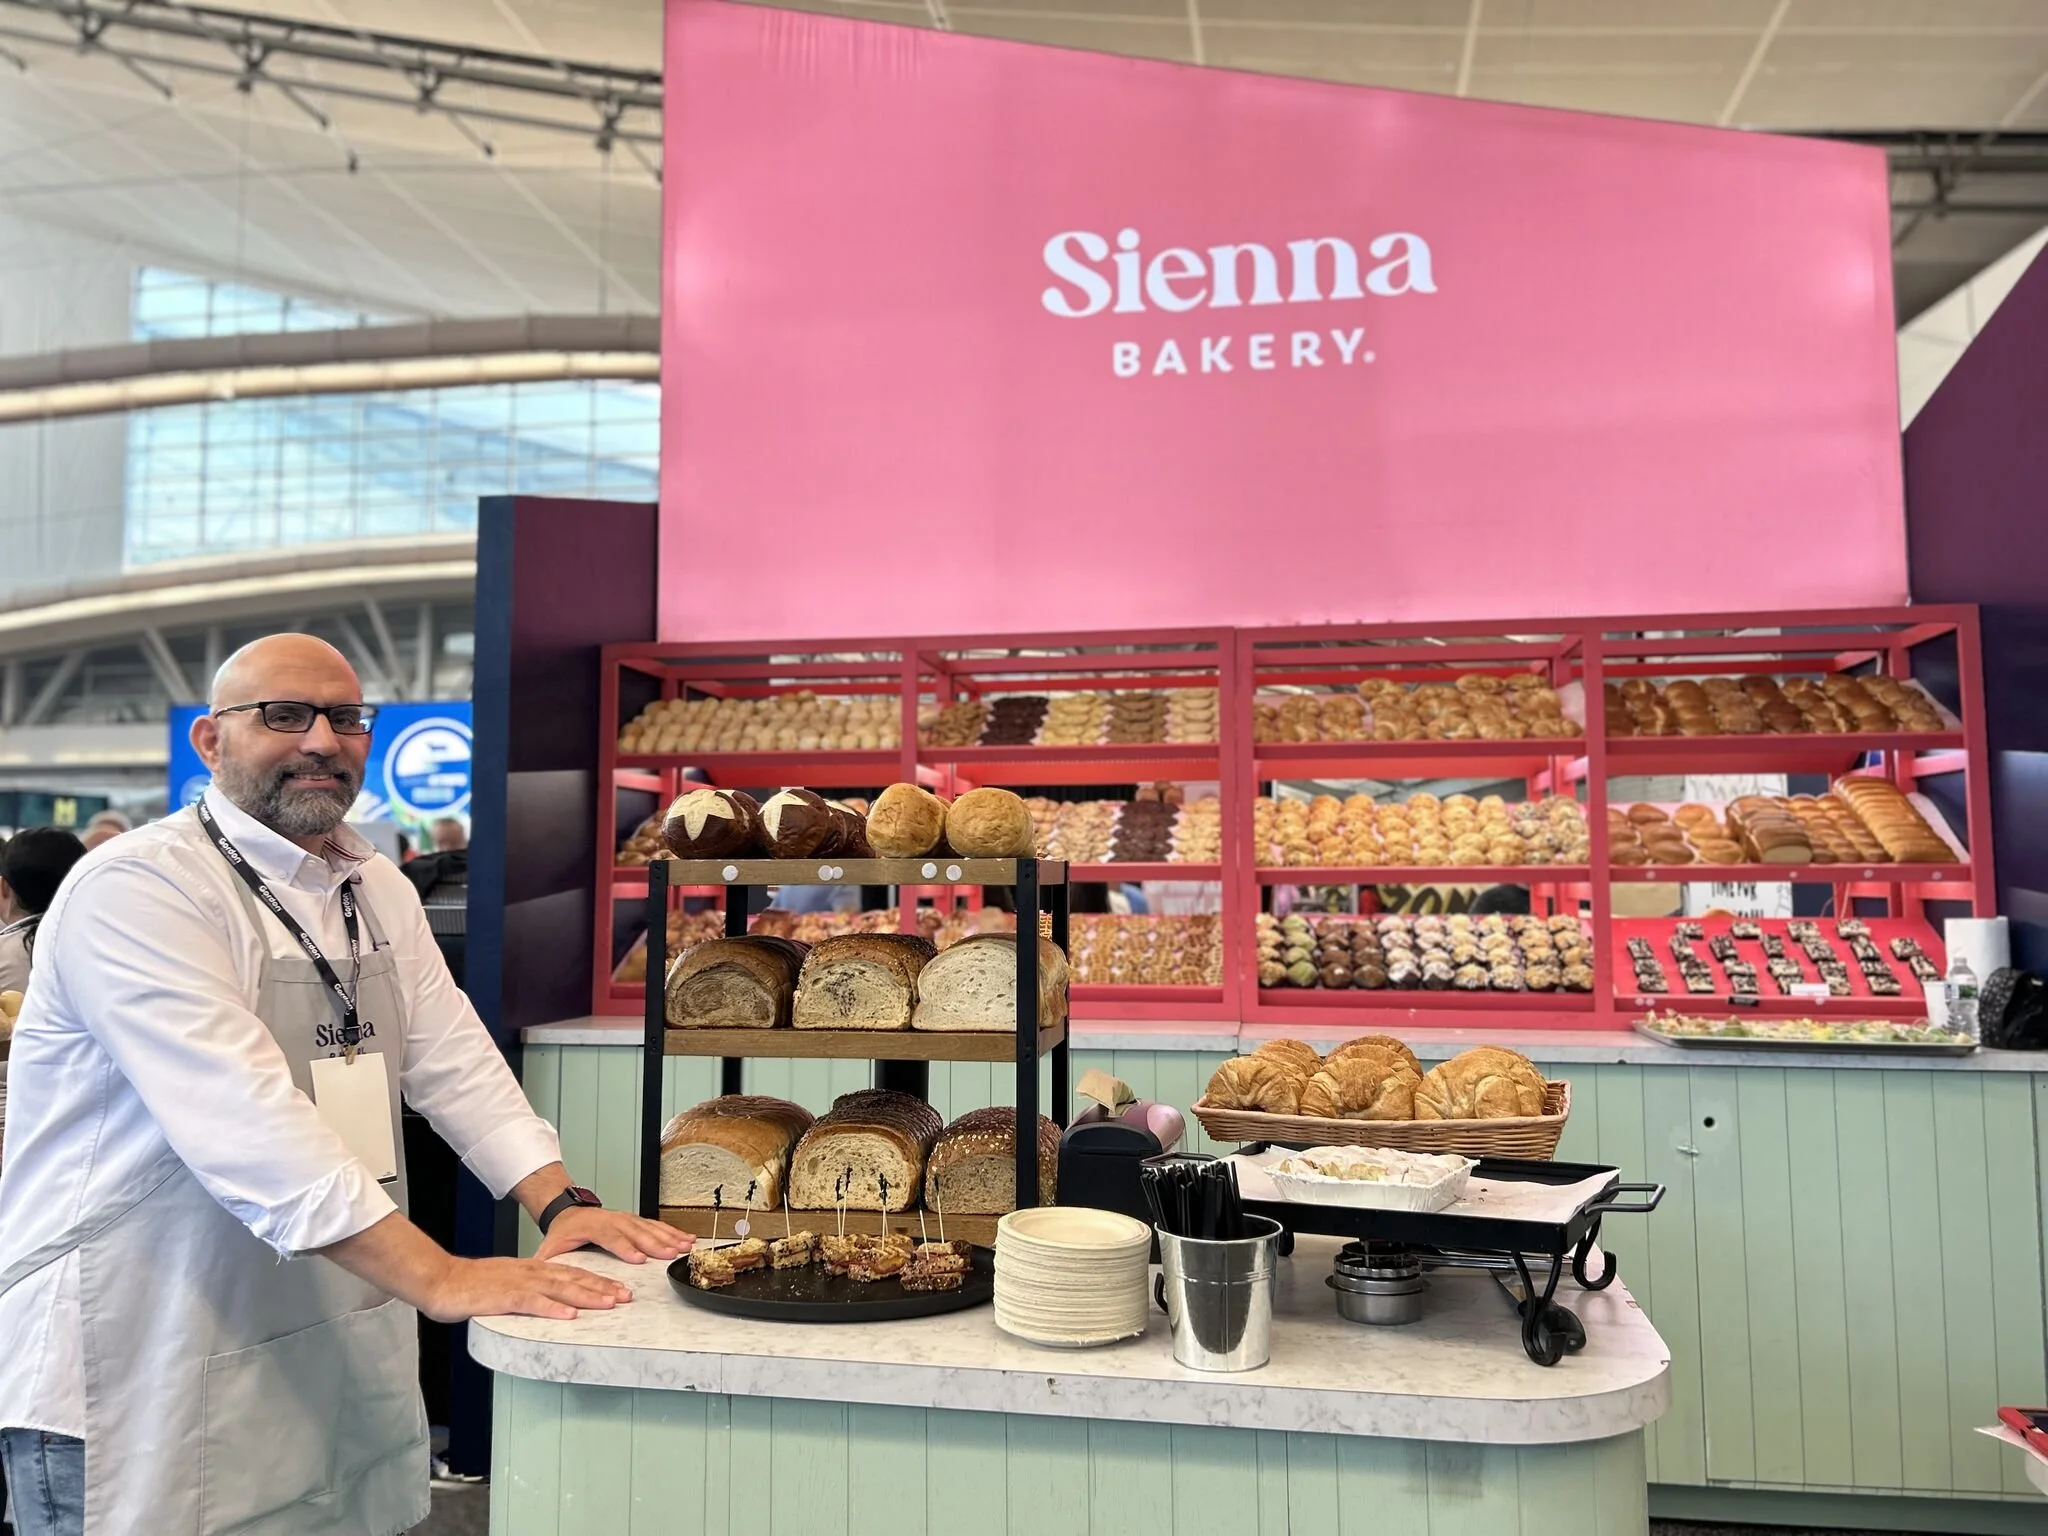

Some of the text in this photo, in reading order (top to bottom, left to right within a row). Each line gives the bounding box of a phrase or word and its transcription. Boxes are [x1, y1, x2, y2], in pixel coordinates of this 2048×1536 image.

[1041, 227, 1438, 318] Sienna
[1112, 328, 1376, 377] BAKERY.
[218, 837, 243, 864] Gordon
[259, 885, 283, 912] Gordon
[342, 892, 352, 918] Gordon
[300, 932, 322, 959] Gordon
[315, 1021, 377, 1048] Siea
